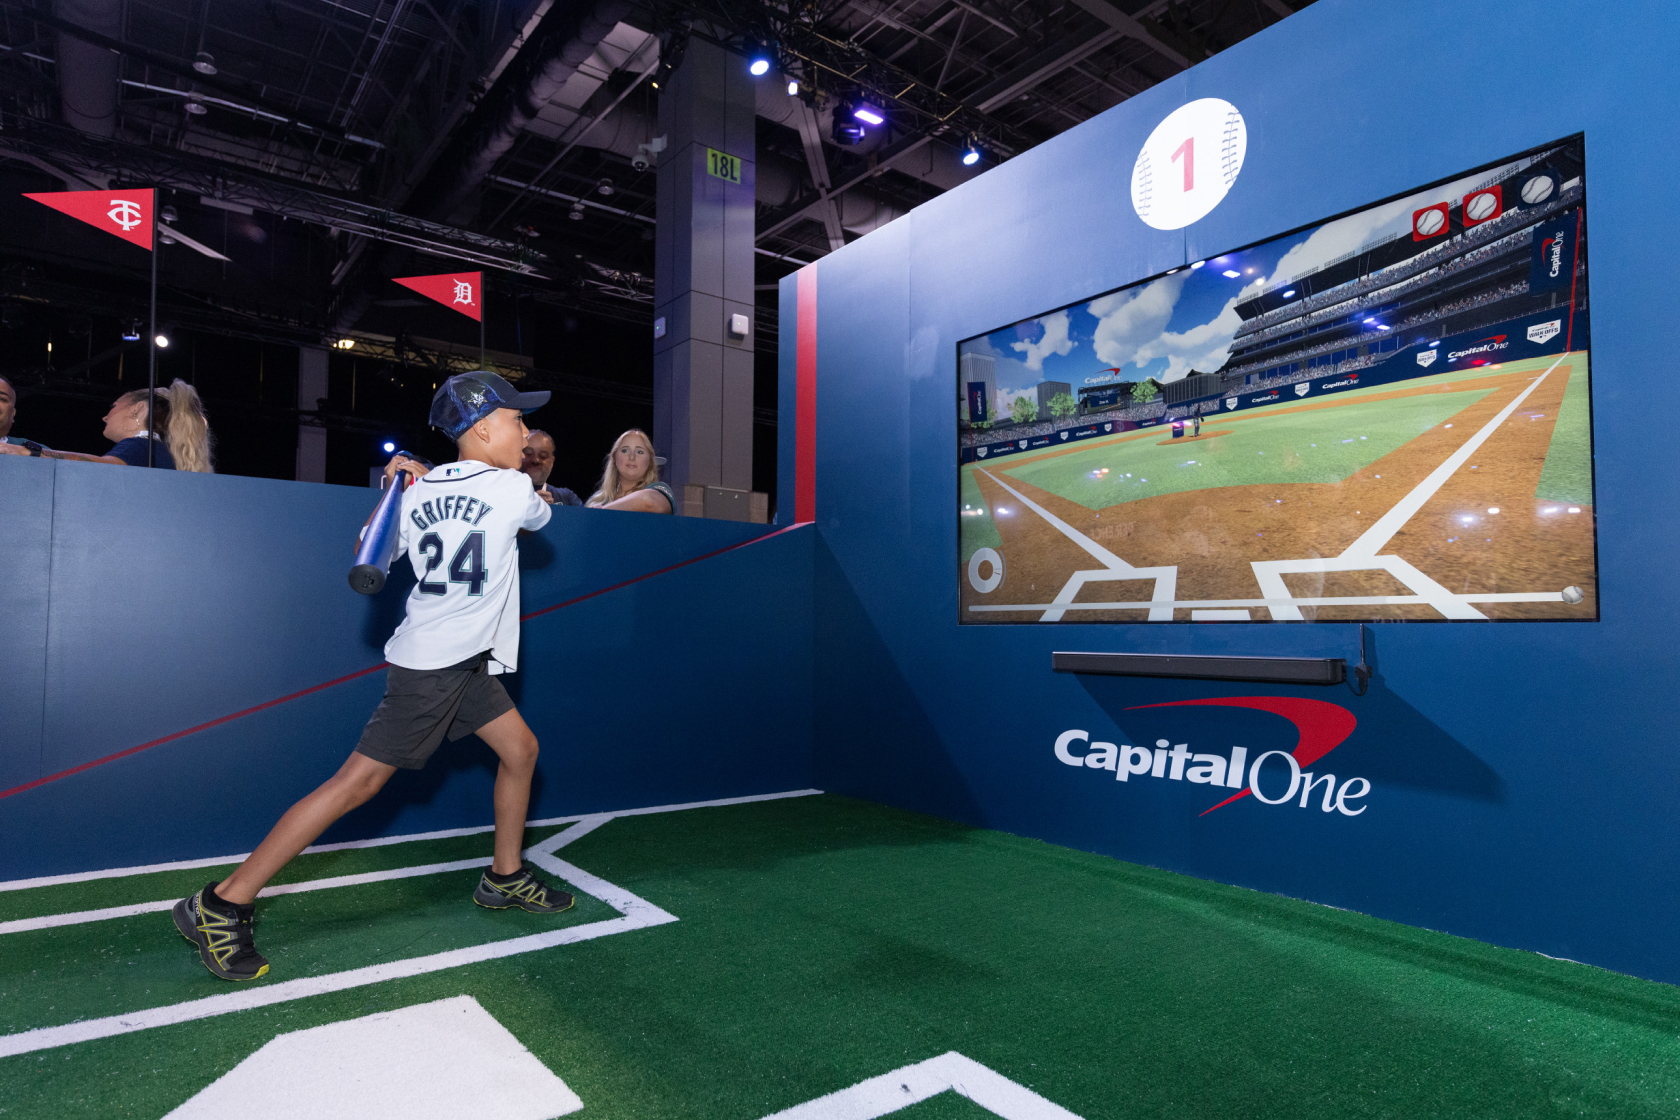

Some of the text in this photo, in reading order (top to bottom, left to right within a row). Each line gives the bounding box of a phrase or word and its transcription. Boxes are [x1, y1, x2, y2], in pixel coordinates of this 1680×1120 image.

[711, 152, 738, 182] 18L
[1171, 137, 1194, 193] 1
[410, 494, 494, 531] GRIFFEY
[418, 530, 489, 597] 24
